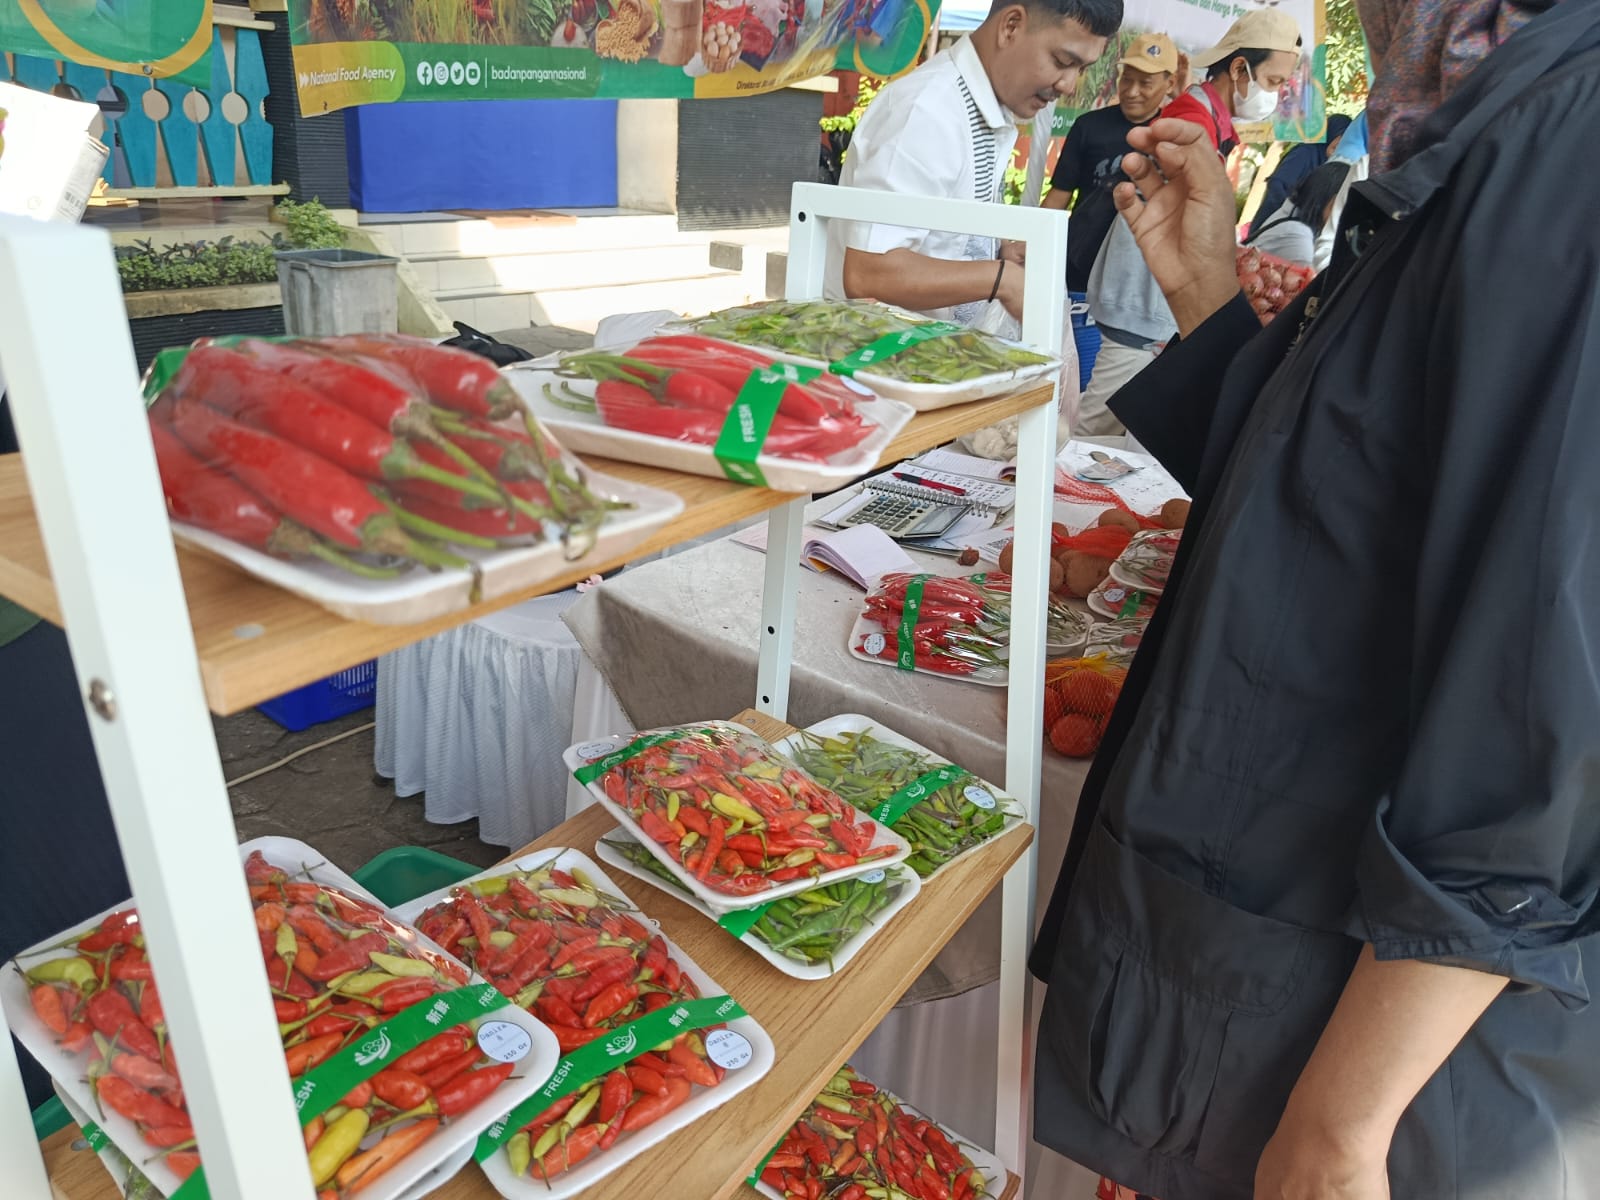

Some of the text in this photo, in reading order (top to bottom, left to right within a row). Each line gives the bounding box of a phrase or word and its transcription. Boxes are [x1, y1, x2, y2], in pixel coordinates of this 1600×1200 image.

[310, 66, 397, 86] National Food Agency
[491, 65, 587, 83] badanpangannasional
[738, 404, 757, 443] FRESH
[878, 802, 892, 823] RESH
[543, 1060, 575, 1098] FRESH
[294, 1080, 317, 1112] ESH
